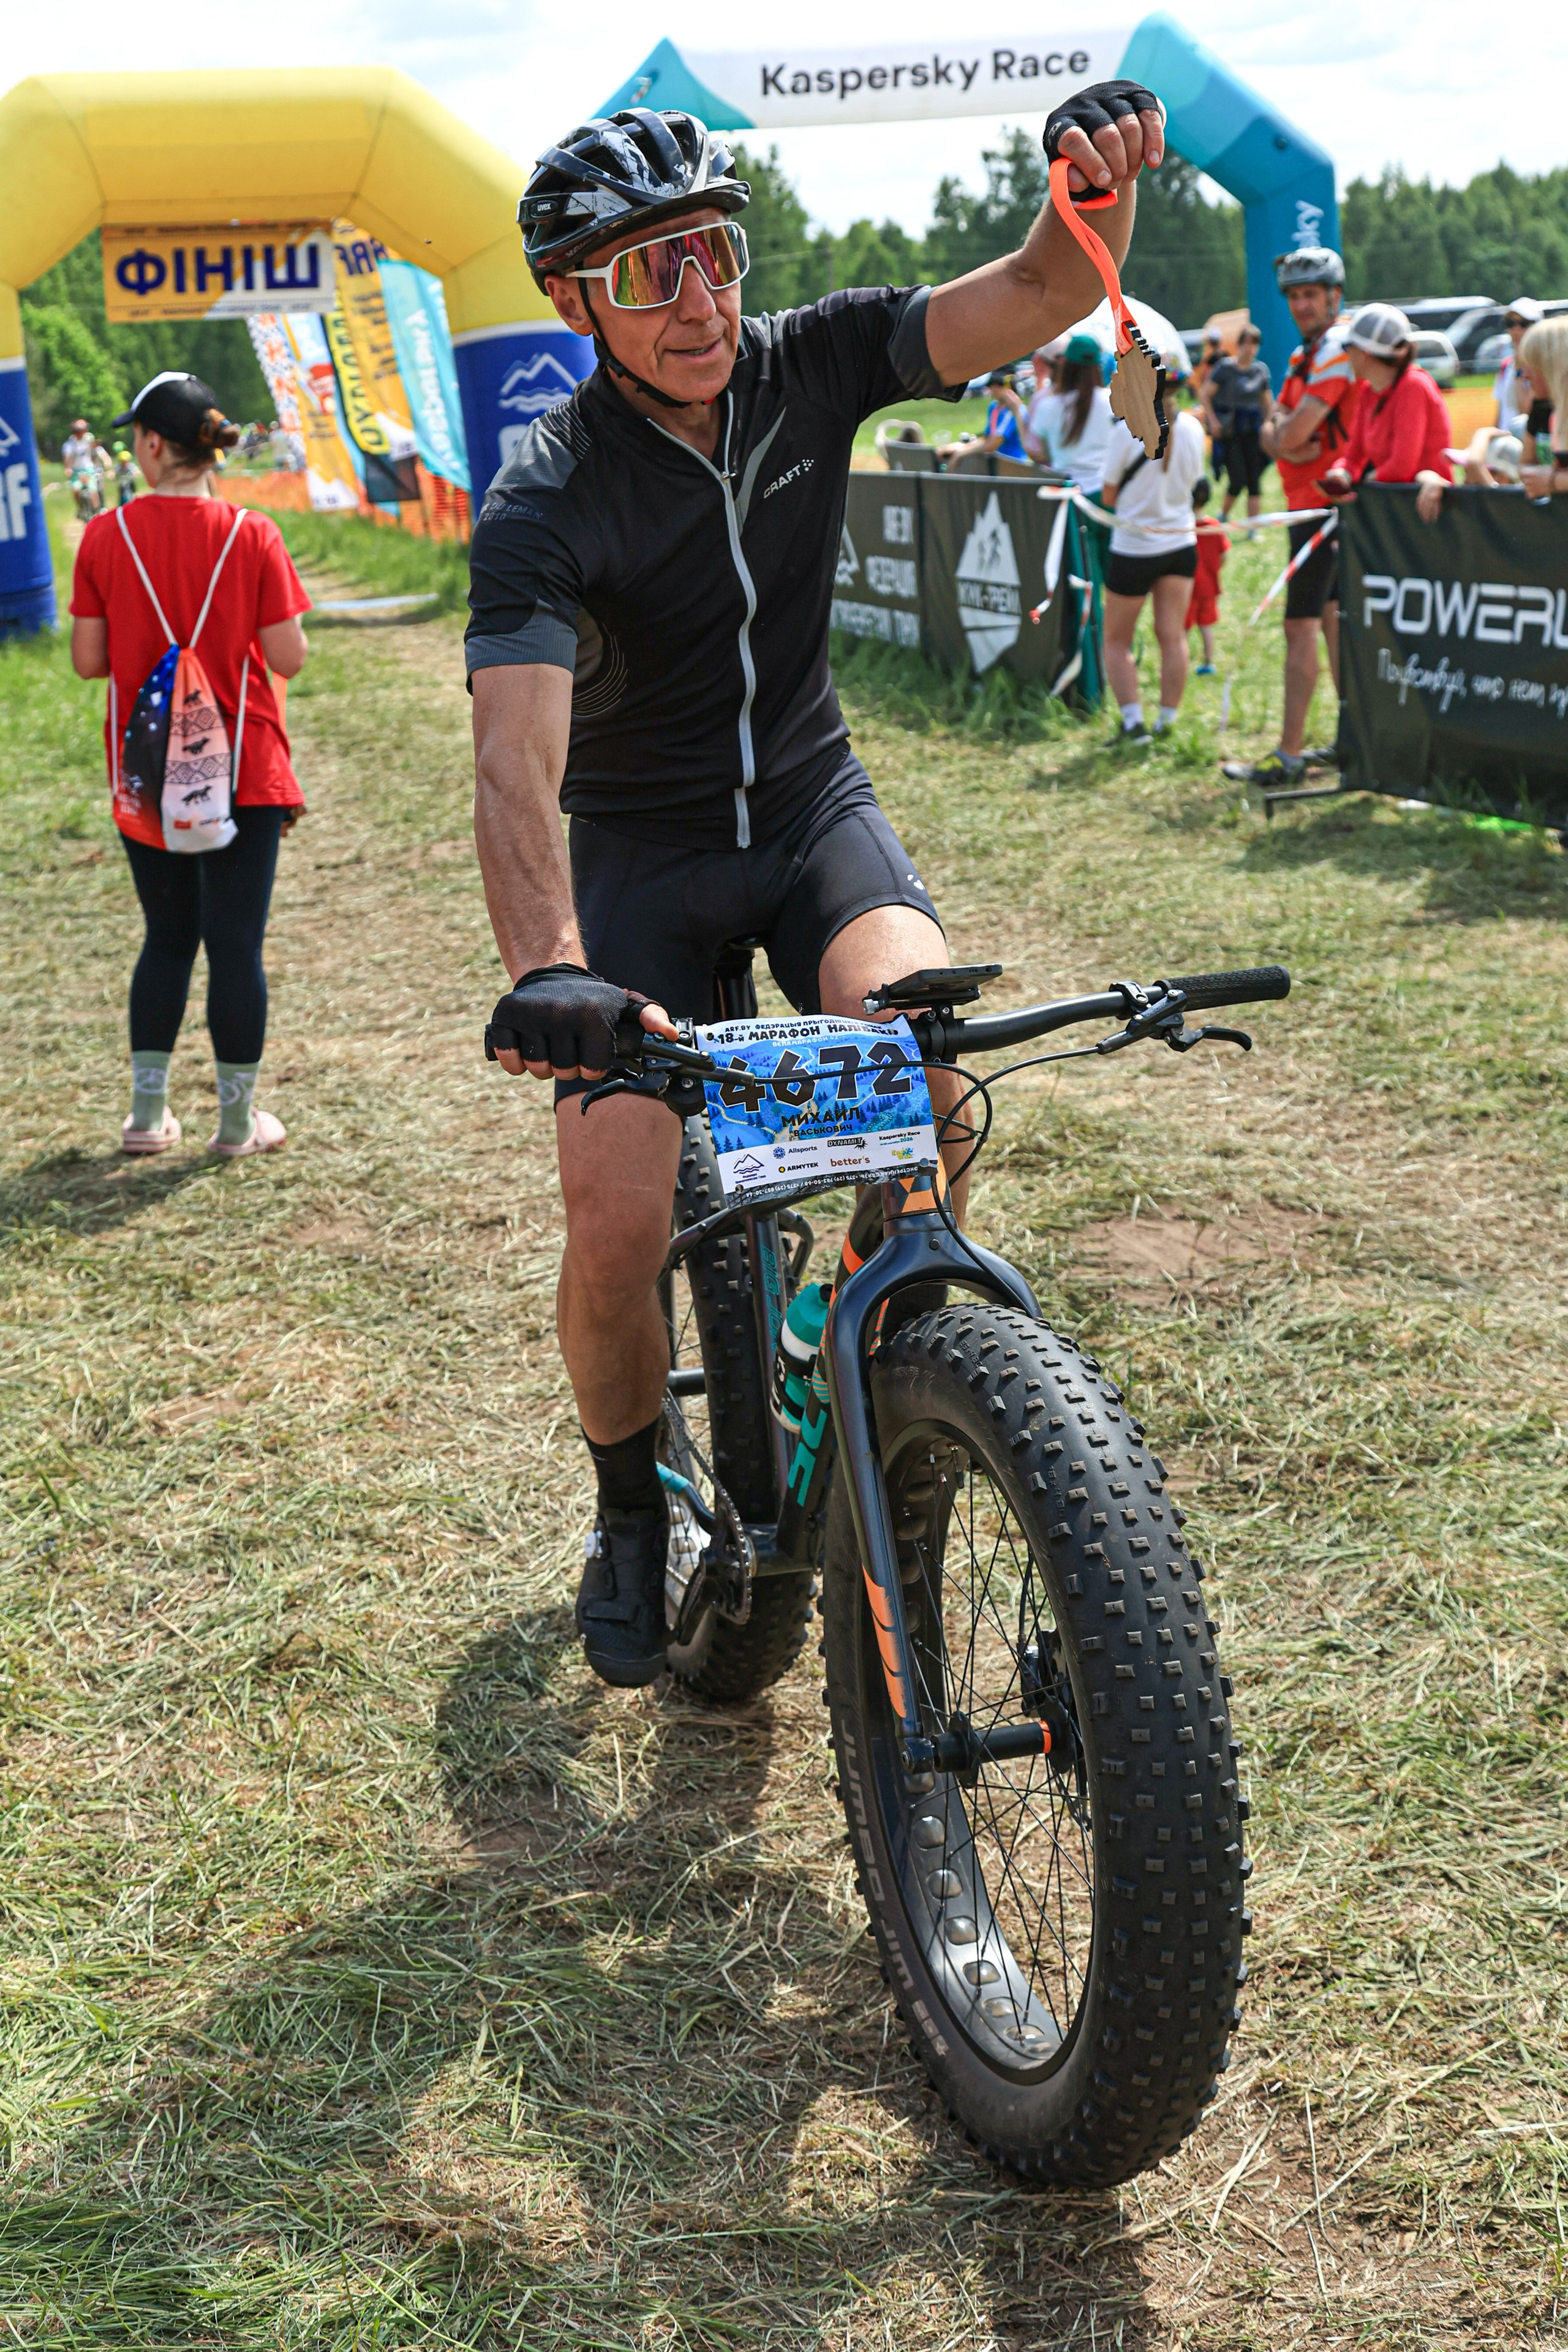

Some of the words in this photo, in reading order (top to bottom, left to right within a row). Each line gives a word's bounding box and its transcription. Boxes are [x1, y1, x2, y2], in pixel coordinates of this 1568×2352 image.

[761, 55, 979, 99] Kaspersky
[992, 49, 1091, 80] Race
[537, 203, 551, 212] uvex
[116, 244, 320, 295] ФІНІШ
[763, 464, 801, 499] CRAFT
[483, 513, 507, 521] 2010
[718, 1033, 744, 1044] 18-й
[748, 1026, 820, 1041] МАРАФОН
[718, 1041, 911, 1113] 4672
[782, 1107, 861, 1128] МИХАИЛ
[794, 1124, 853, 1137] ВАСЬКОВИЧ
[787, 1163, 819, 1171] ARMYTEK
[830, 1156, 870, 1167] better's
[760, 1245, 780, 1295] BIG
[841, 1719, 886, 1901] JUMBO
[880, 1915, 914, 1990] JIM
